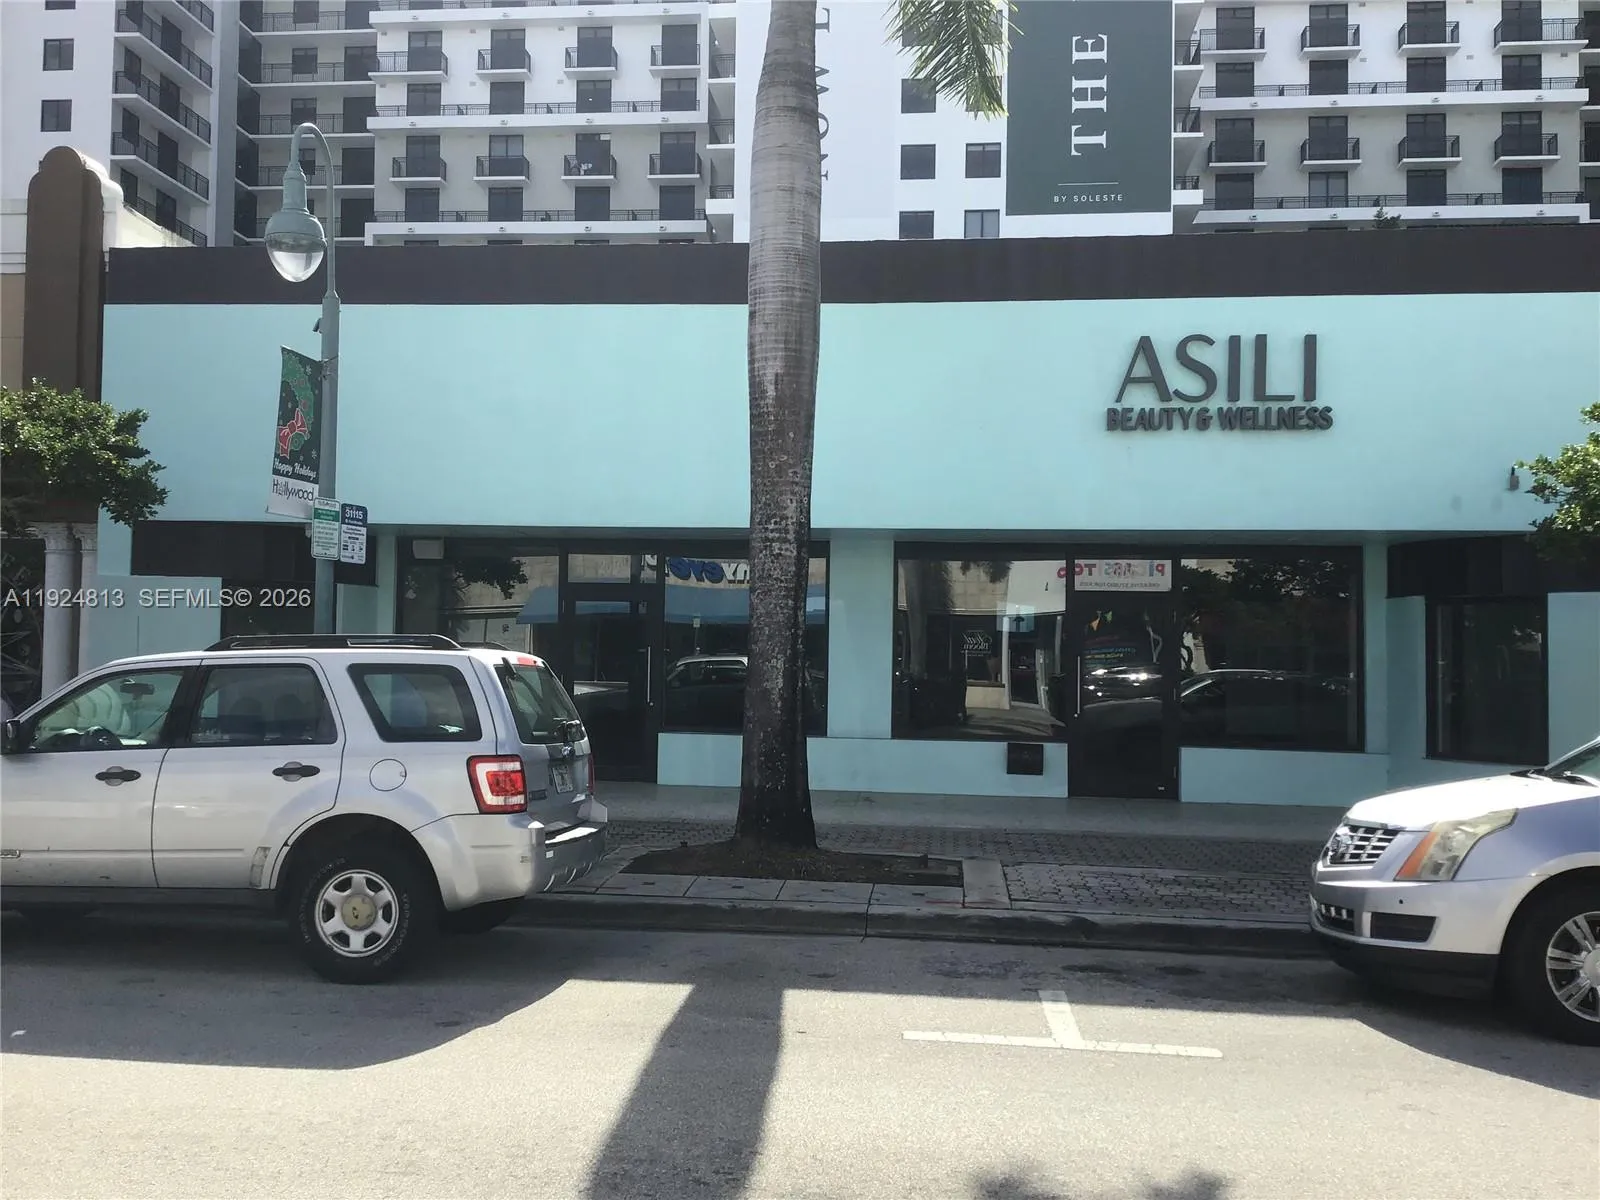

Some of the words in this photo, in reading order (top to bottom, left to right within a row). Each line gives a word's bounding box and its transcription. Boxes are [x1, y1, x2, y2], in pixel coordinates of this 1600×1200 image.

[1071, 33, 1108, 156] THE
[1053, 195, 1067, 203] BY
[1073, 194, 1123, 203] SOLESTE
[1115, 333, 1318, 403] ASILI
[1106, 406, 1195, 431] BEAUTY
[1196, 406, 1214, 431] &
[1217, 405, 1334, 431] WELLNESS
[273, 458, 293, 476] Happy
[294, 462, 317, 481] Holidays
[272, 478, 315, 501] Hollywood
[345, 509, 363, 519] 31115
